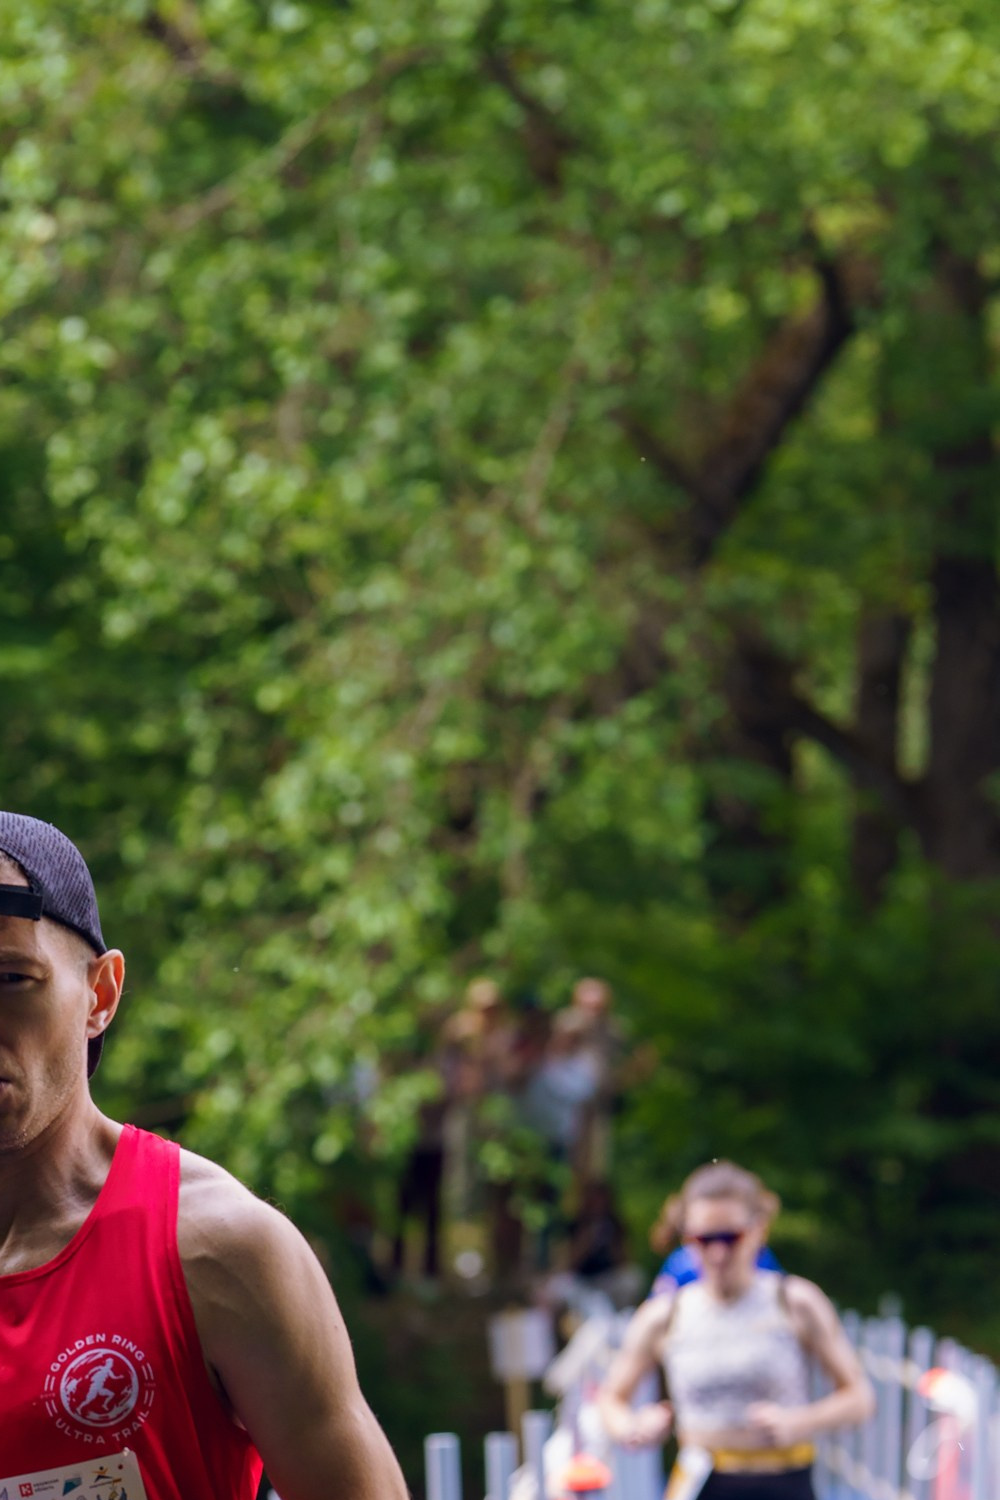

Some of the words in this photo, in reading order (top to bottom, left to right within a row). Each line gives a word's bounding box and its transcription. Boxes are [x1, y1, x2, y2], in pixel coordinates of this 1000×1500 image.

[50, 1333, 106, 1372] GOLDEN
[112, 1334, 145, 1361] RING
[55, 1418, 105, 1444] ULTRA
[112, 1410, 149, 1441] TRAIL
